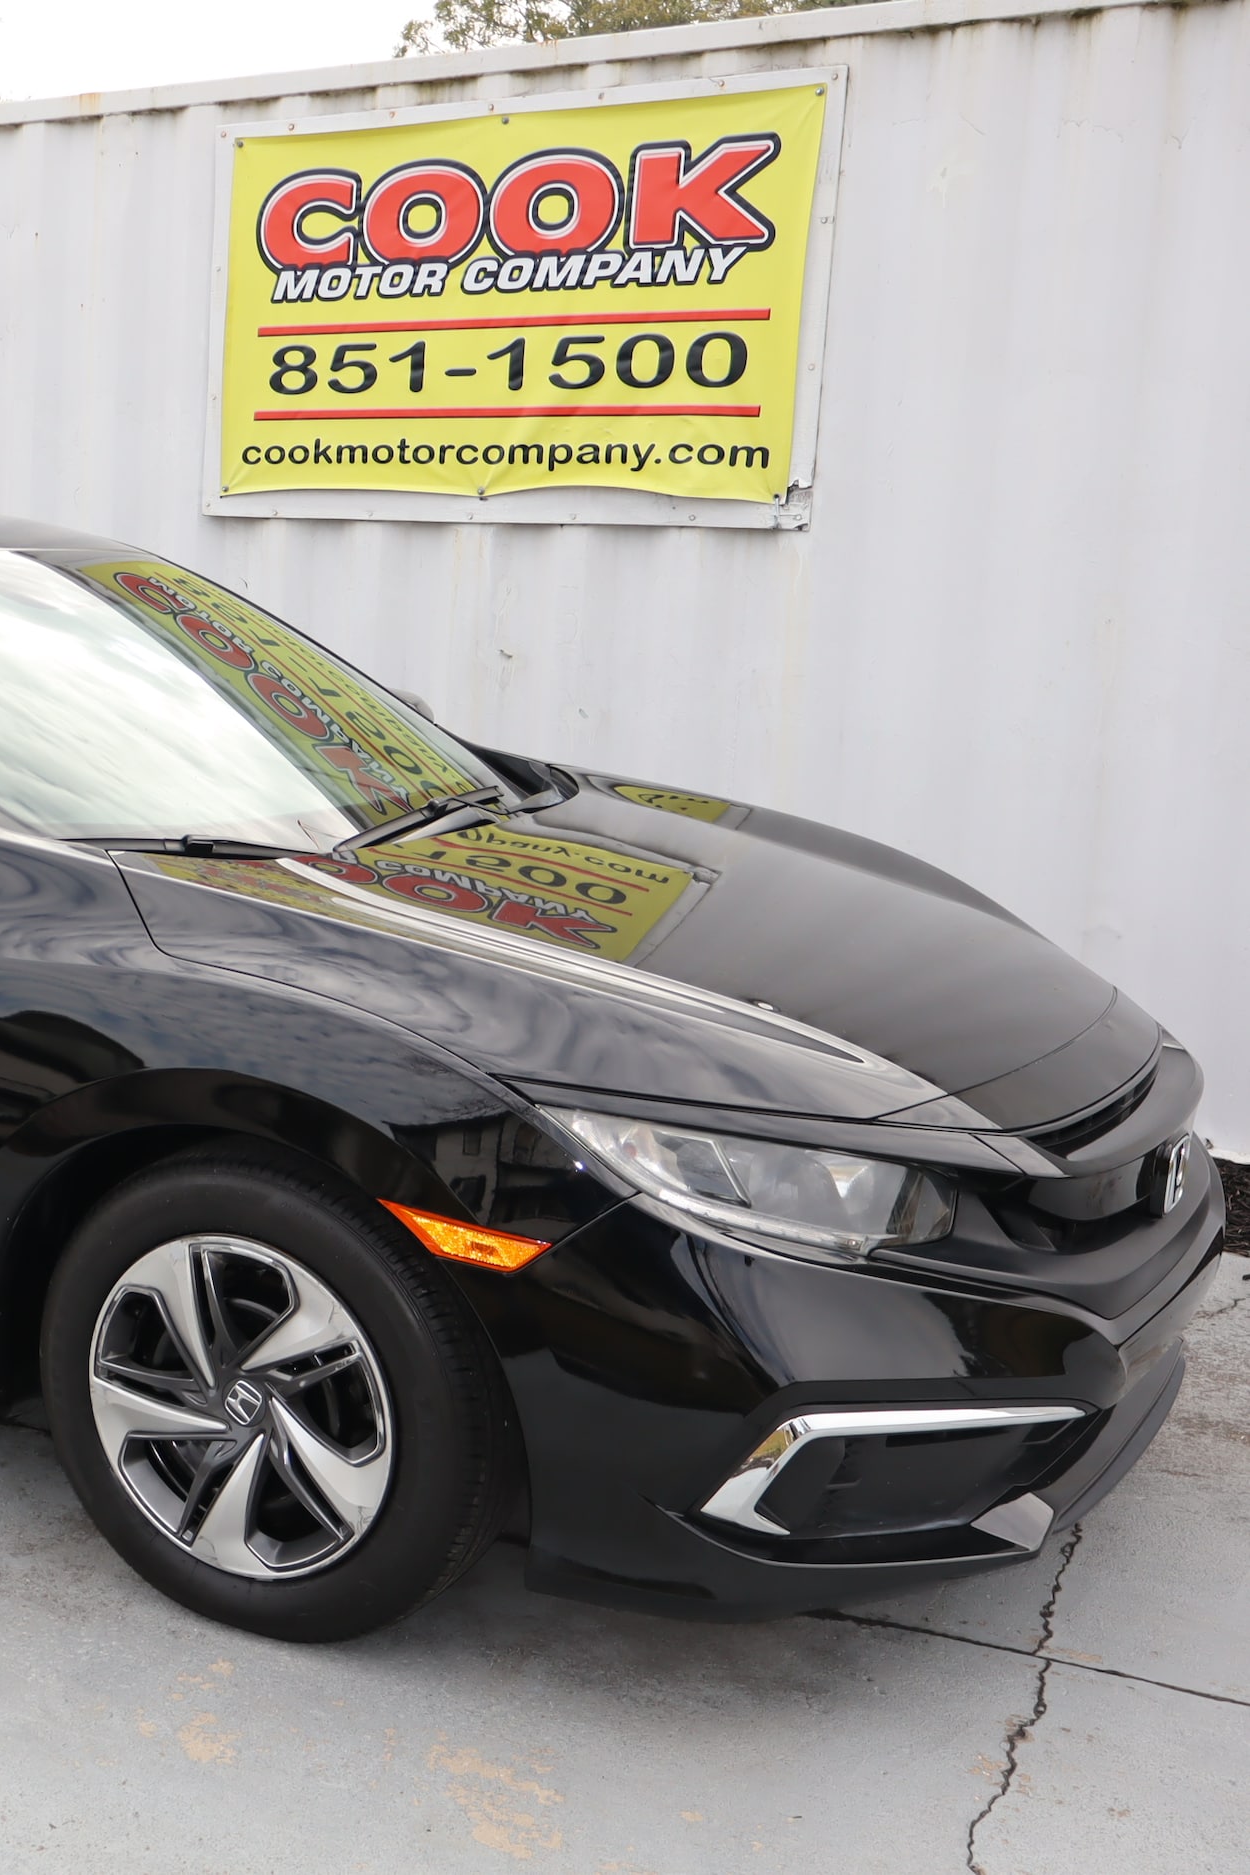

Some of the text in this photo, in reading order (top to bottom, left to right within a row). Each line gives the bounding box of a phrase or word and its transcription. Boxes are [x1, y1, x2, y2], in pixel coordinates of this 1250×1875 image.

[257, 132, 781, 270] COOK
[271, 245, 750, 303] MOTOR COMPANY
[268, 331, 748, 395] 851-1500
[241, 437, 770, 472] cookmotorcompany.com
